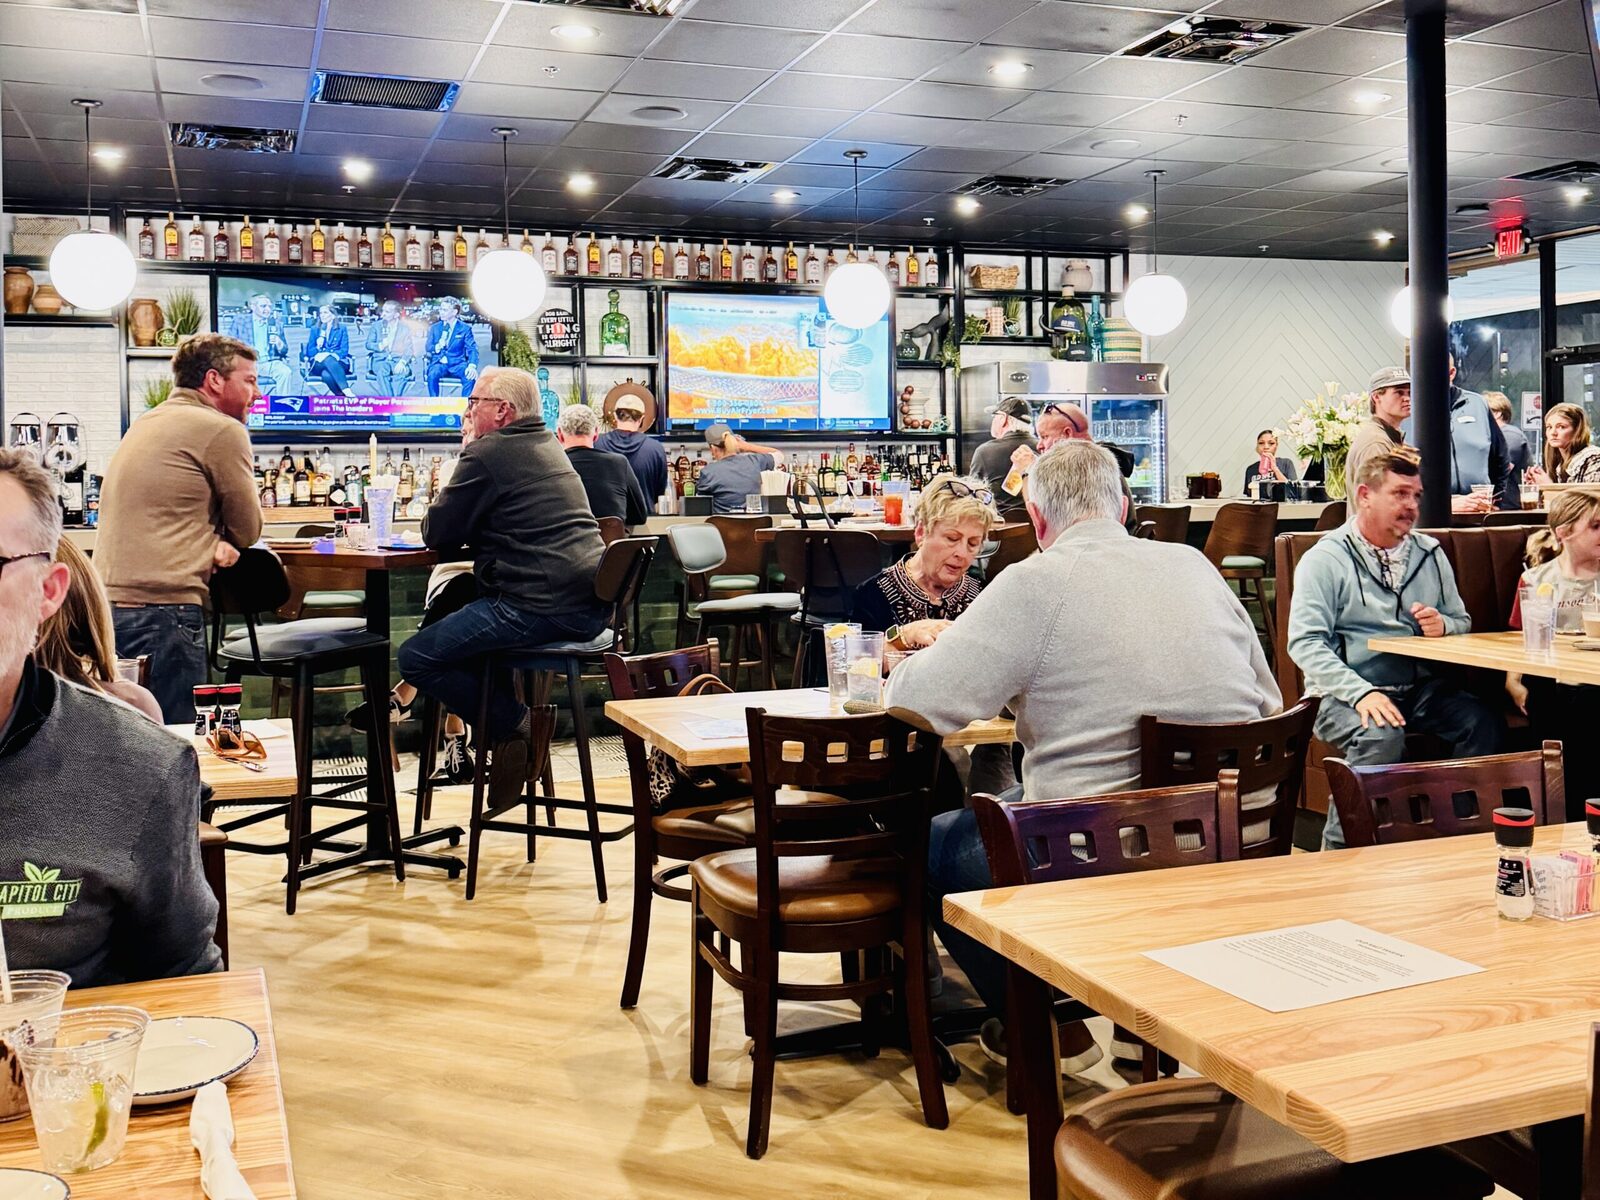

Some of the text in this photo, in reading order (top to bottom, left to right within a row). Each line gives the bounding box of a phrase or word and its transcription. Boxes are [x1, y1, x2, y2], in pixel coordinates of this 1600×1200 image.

[1500, 230, 1522, 256] EXIT
[537, 323, 580, 334] THING
[544, 339, 576, 347] ALRIGHT
[368, 398, 390, 406] Player
[0, 884, 47, 903] APITOL
